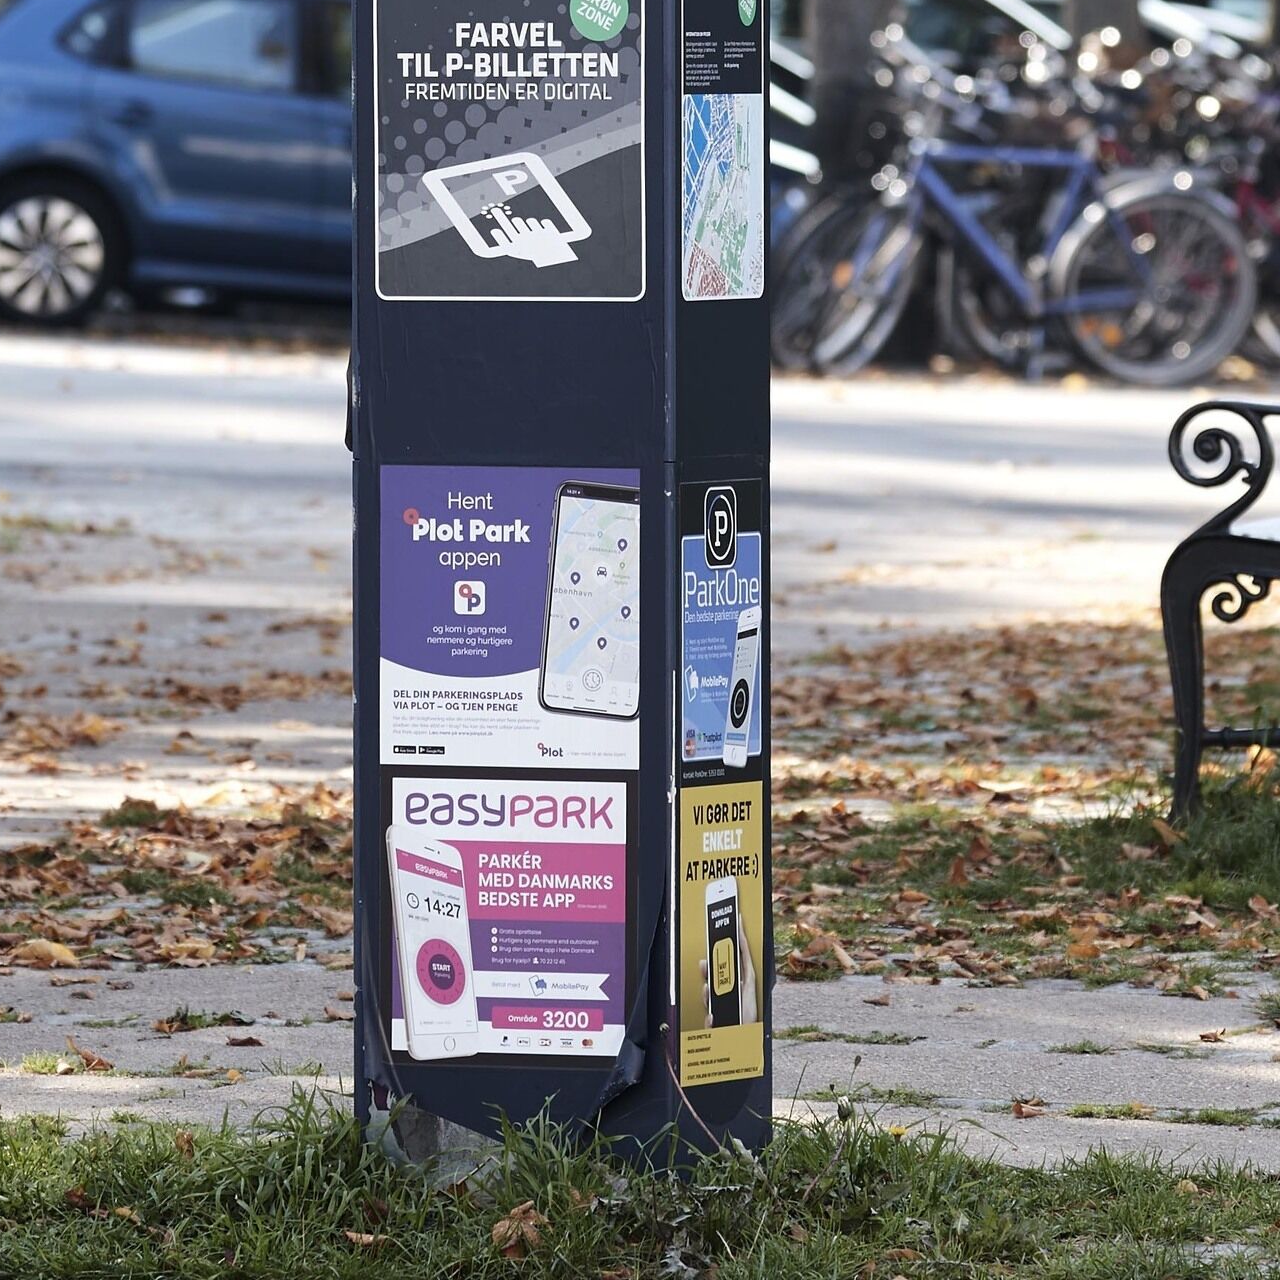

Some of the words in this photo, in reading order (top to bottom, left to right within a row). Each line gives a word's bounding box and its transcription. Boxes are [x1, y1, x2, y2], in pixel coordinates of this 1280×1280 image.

[576, 1, 615, 32] ZONE
[455, 22, 562, 48] FARVEL
[397, 52, 439, 78] TIL
[446, 52, 619, 78] P-BILLETTEN
[405, 83, 510, 101] FREMTIDEN
[515, 83, 539, 101] ER
[544, 83, 612, 101] DIGITAL
[492, 170, 529, 196] P
[448, 492, 493, 510] Hent
[412, 518, 463, 542] Plot
[470, 519, 531, 543] Park
[714, 510, 728, 547] P
[439, 551, 501, 570] appen
[684, 569, 760, 608] ParkOne
[432, 626, 443, 634] og
[445, 625, 462, 633] kom
[467, 626, 487, 635] gang
[489, 626, 507, 634] med
[466, 638, 476, 646] og
[477, 636, 513, 647] hurtigere
[451, 648, 488, 657] parkering
[701, 676, 728, 688] MobilePay
[393, 690, 411, 698] DEL
[413, 690, 430, 699] DIN
[432, 690, 523, 700] PARKERINGSPLADS
[393, 702, 409, 710] VIA
[411, 702, 435, 710] PLOT
[445, 702, 460, 711] OG
[461, 703, 484, 711] TJEN
[486, 703, 518, 712] PENGE
[693, 805, 704, 825] VI
[706, 803, 729, 824] GØR
[732, 800, 752, 821] DET
[703, 829, 743, 853] ENKELT
[478, 850, 542, 870] PARKÉR
[686, 861, 700, 881] AT
[702, 856, 750, 880] PARKERE
[478, 873, 514, 888] MED
[518, 874, 614, 890] DANMARKS
[424, 897, 460, 918] 14:27
[478, 892, 538, 907] BEDSTE
[543, 893, 576, 908] APP
[432, 963, 451, 972] START
[551, 983, 589, 991] MobilePay
[508, 1013, 538, 1023] Område
[543, 1011, 589, 1029] 3200
